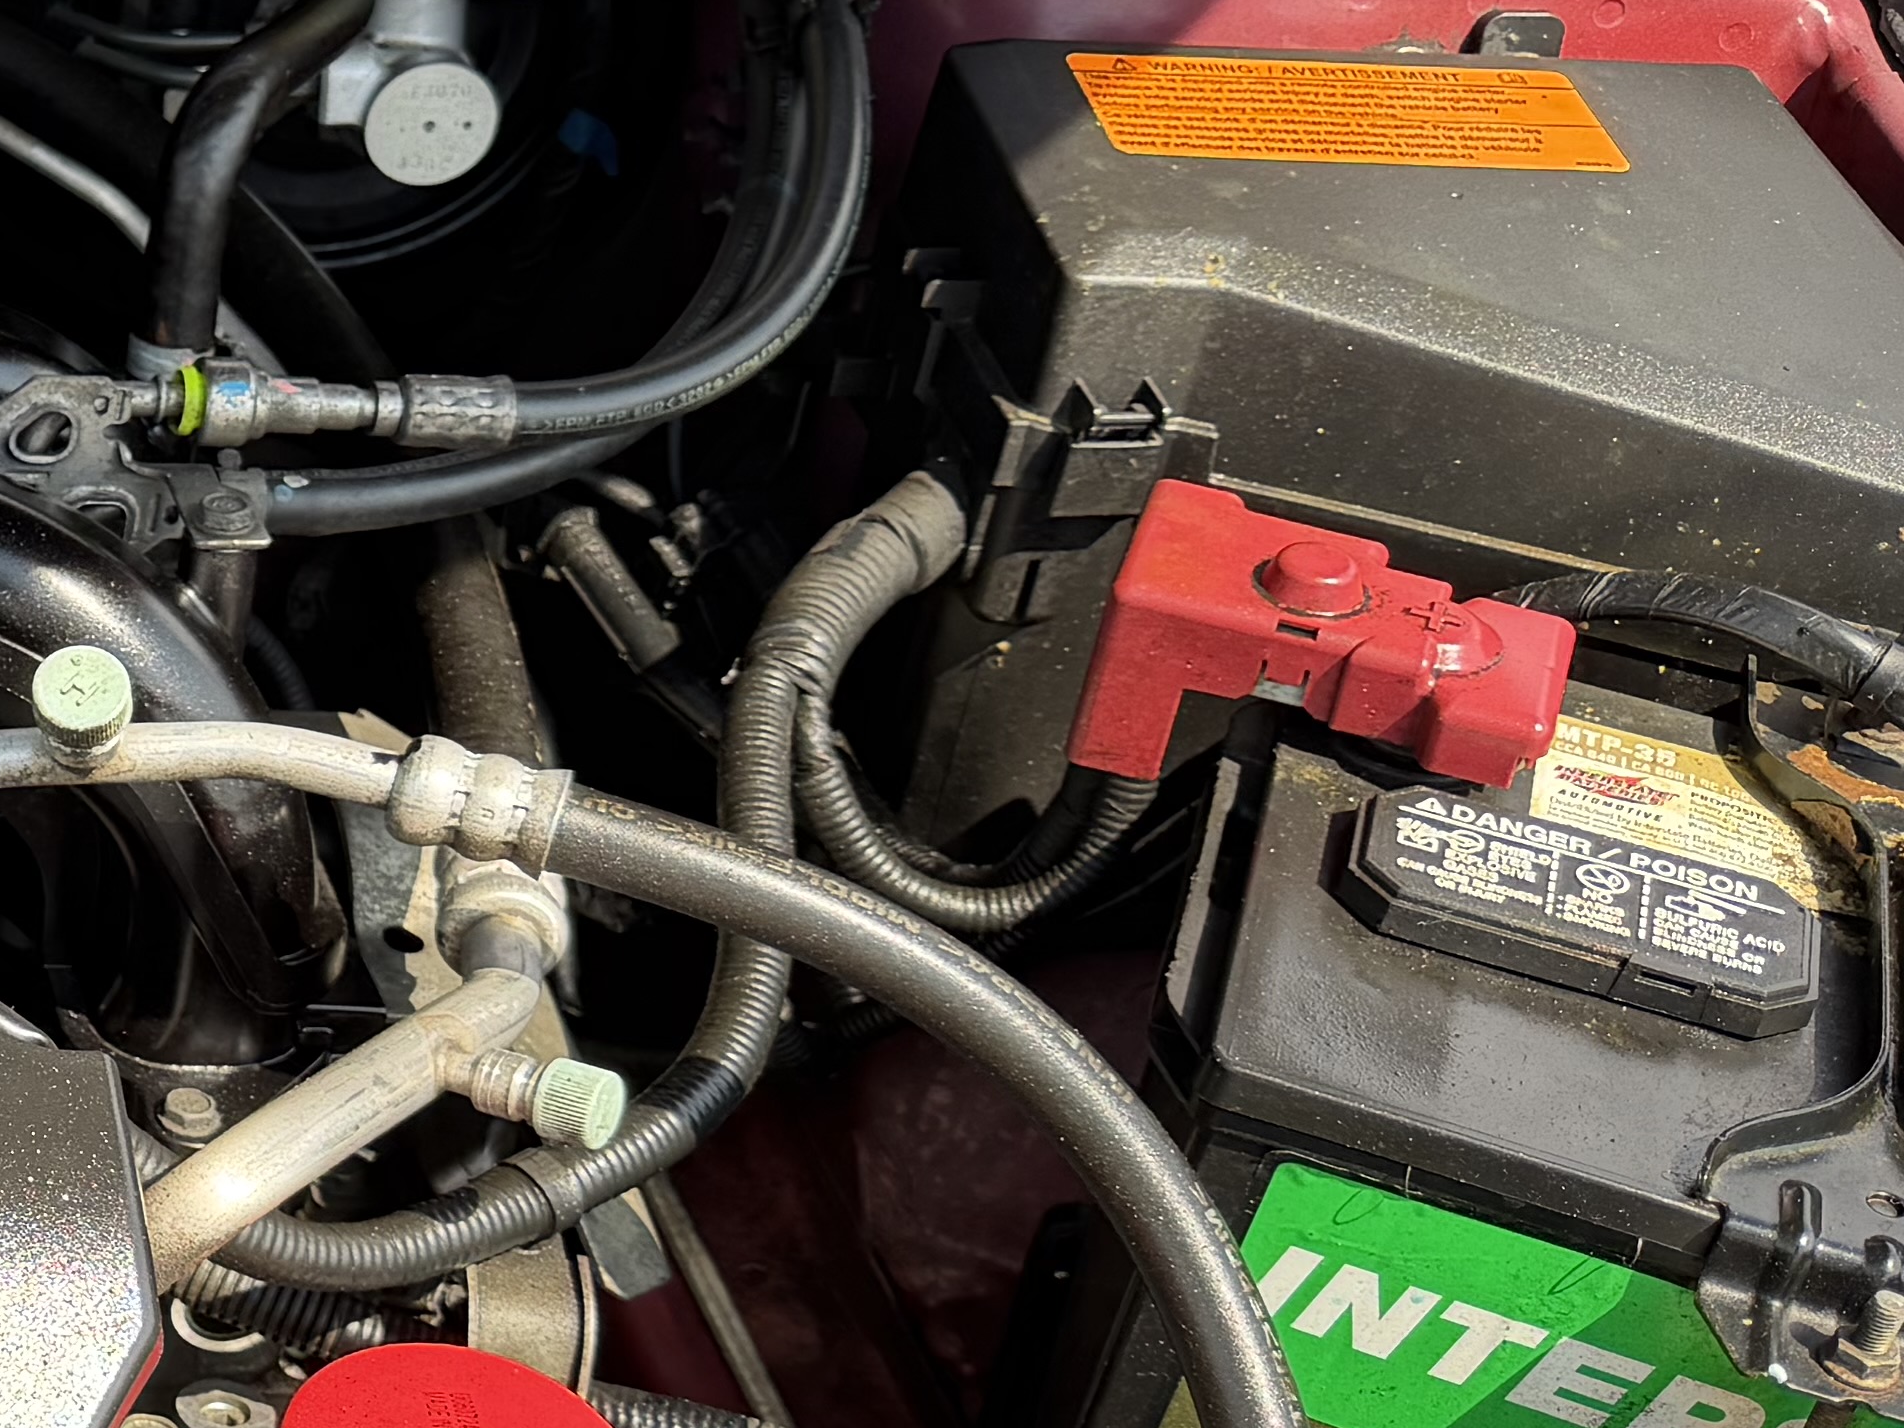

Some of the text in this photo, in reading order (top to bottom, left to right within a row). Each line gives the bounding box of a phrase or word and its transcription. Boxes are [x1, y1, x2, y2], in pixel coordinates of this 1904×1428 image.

[1281, 67, 1460, 83] AVERTISSEMENT
[1558, 723, 1677, 767] MTP-35
[1558, 788, 1662, 822] AUTOMOTIVE
[1444, 848, 1538, 883] EXPLOSIVE
[1452, 804, 1592, 856] DANGER
[1629, 852, 1758, 901] POISON
[1489, 841, 1553, 866] SHIELD
[1582, 887, 1614, 905] NO
[1653, 917, 1739, 951] CAN CAUSE
[1653, 927, 1736, 959] BLINDNESS
[1654, 907, 1786, 954] SULFURIC ACID
[1652, 936, 1763, 975] SEVERE BURNS
